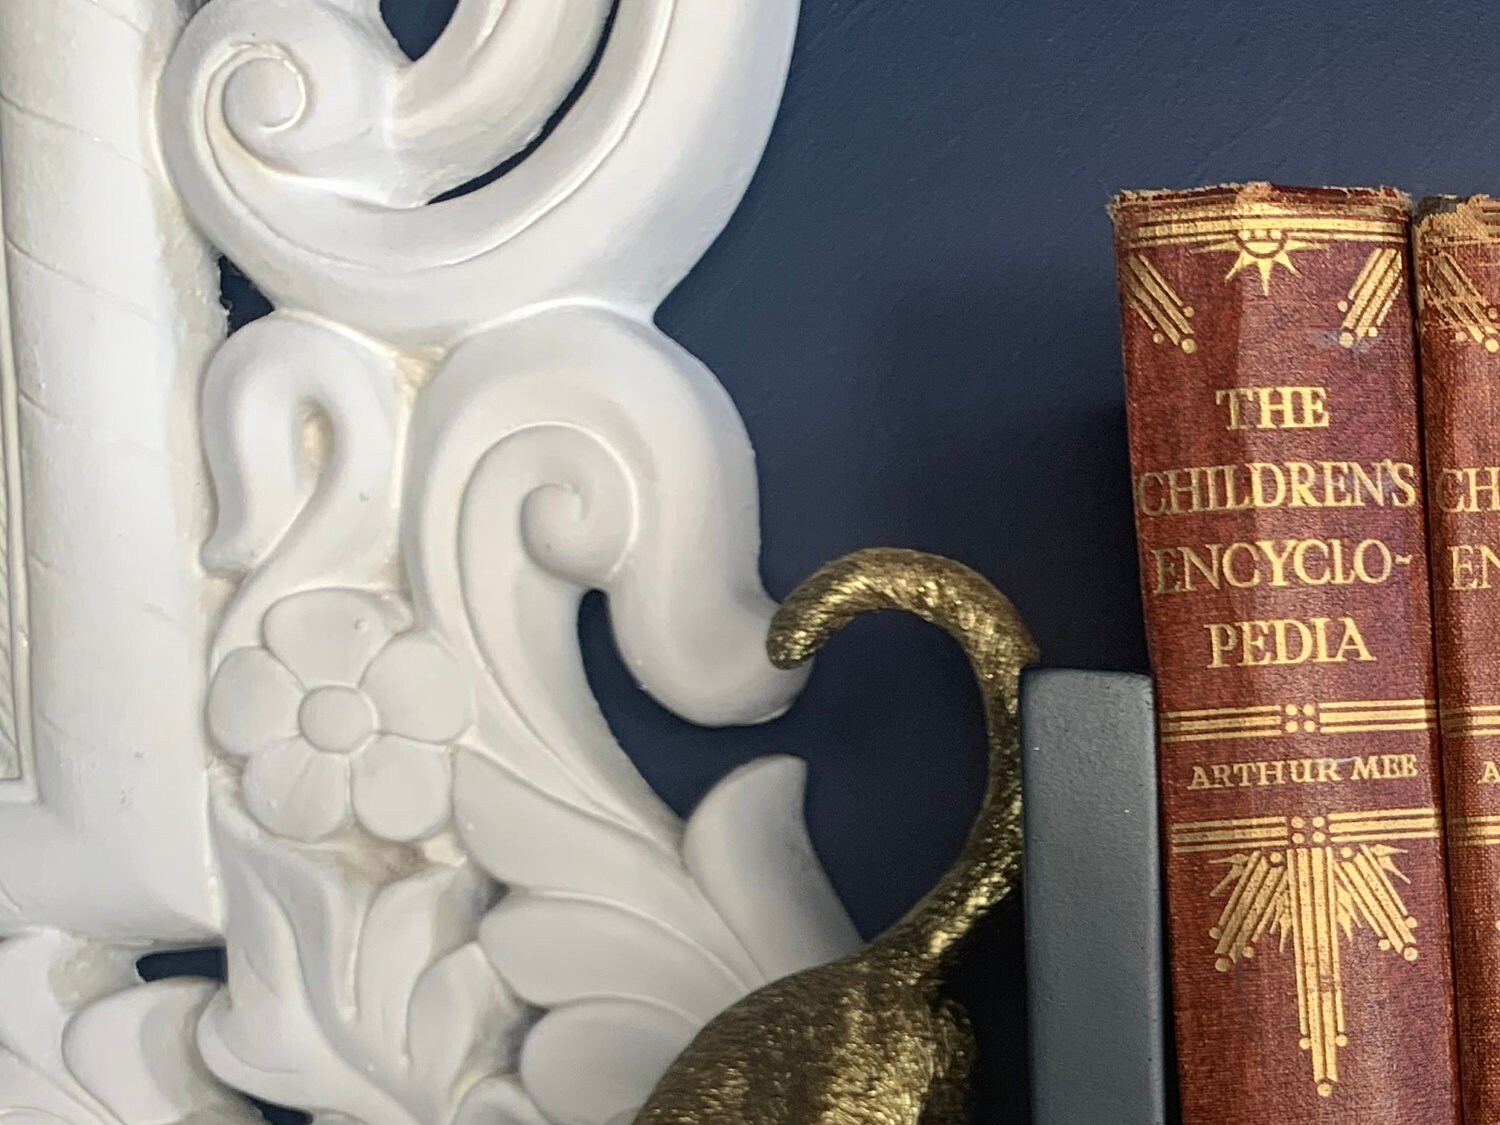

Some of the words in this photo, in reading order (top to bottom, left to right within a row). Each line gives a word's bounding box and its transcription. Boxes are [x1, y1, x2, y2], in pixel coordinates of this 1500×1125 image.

[1216, 386, 1330, 430] THE
[1137, 458, 1417, 516] CHILDREN'S
[1152, 538, 1413, 594] ENCYCLO-
[1204, 616, 1377, 669] PEDIA
[1187, 756, 1342, 791] ARTHUR
[1350, 753, 1418, 781] MEE
